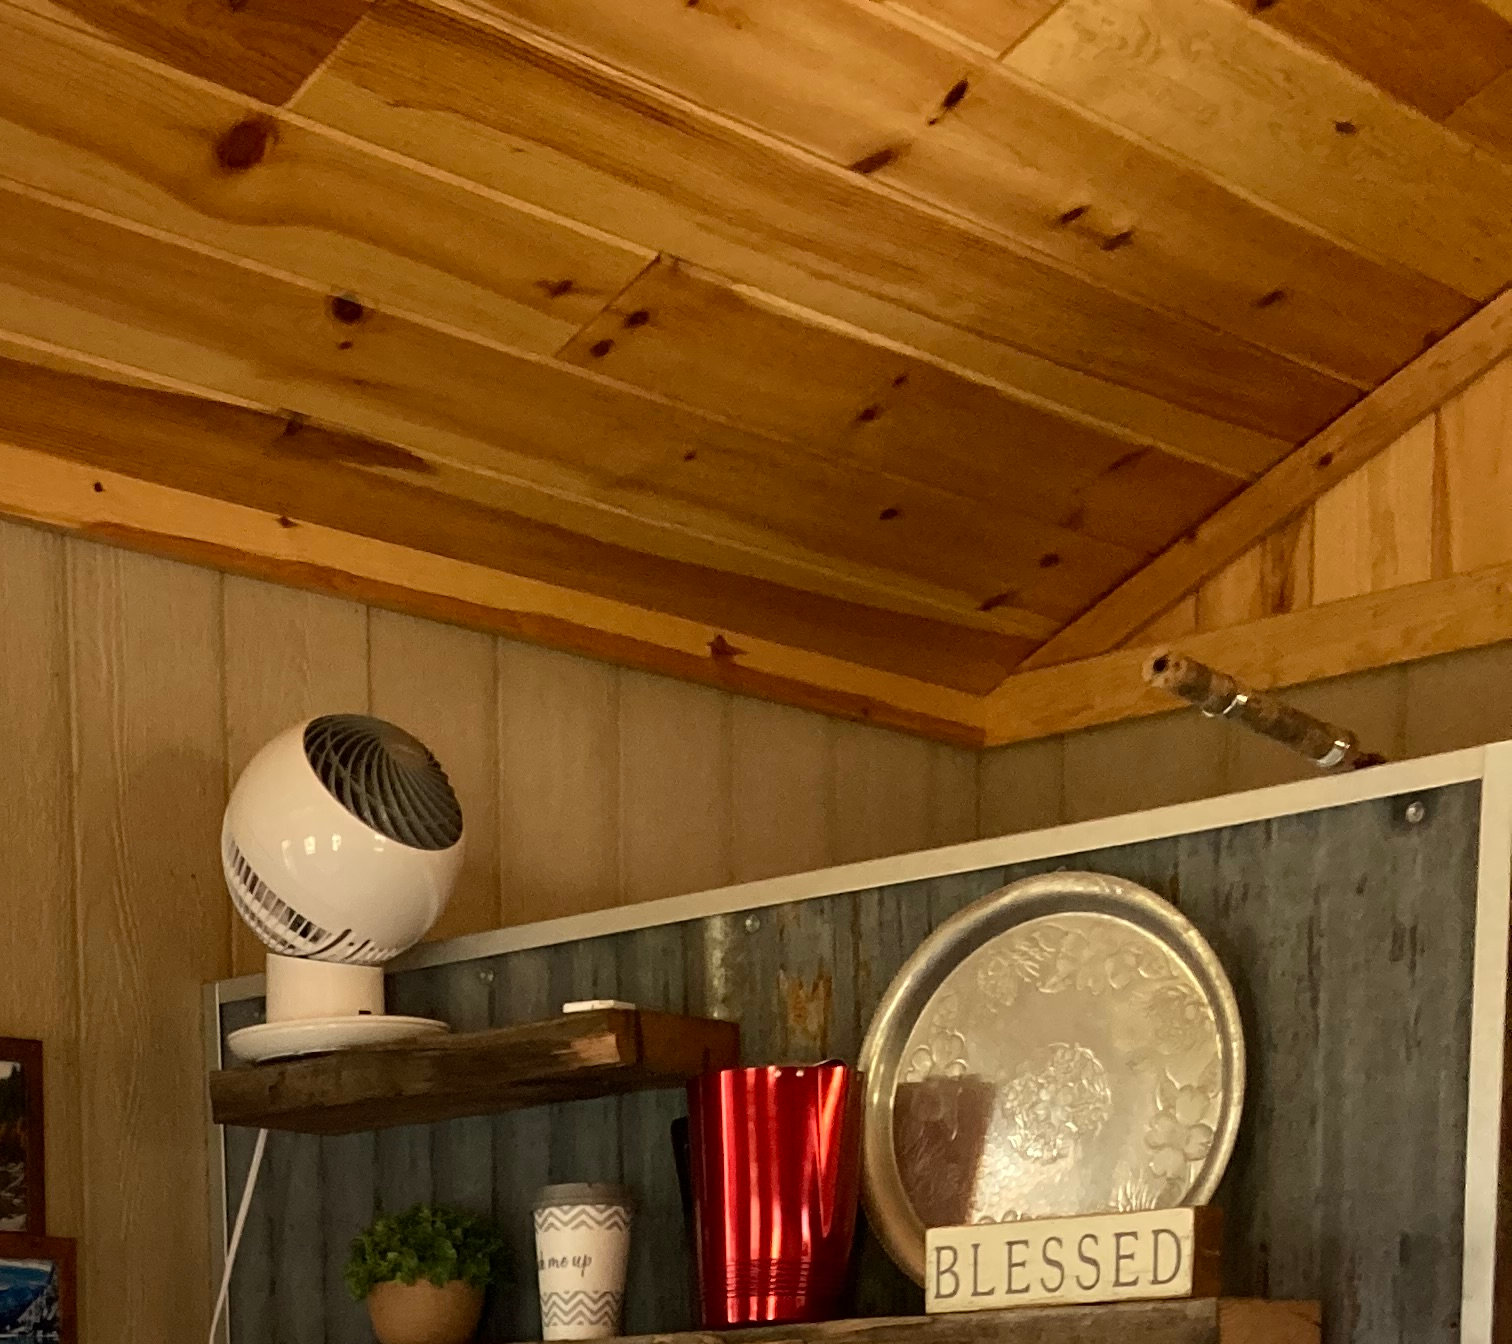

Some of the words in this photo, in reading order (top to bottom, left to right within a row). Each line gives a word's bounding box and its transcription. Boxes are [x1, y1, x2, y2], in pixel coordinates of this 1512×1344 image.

[548, 1256, 568, 1269] me
[572, 1254, 593, 1278] up
[934, 1228, 1182, 1299] BLESSED
